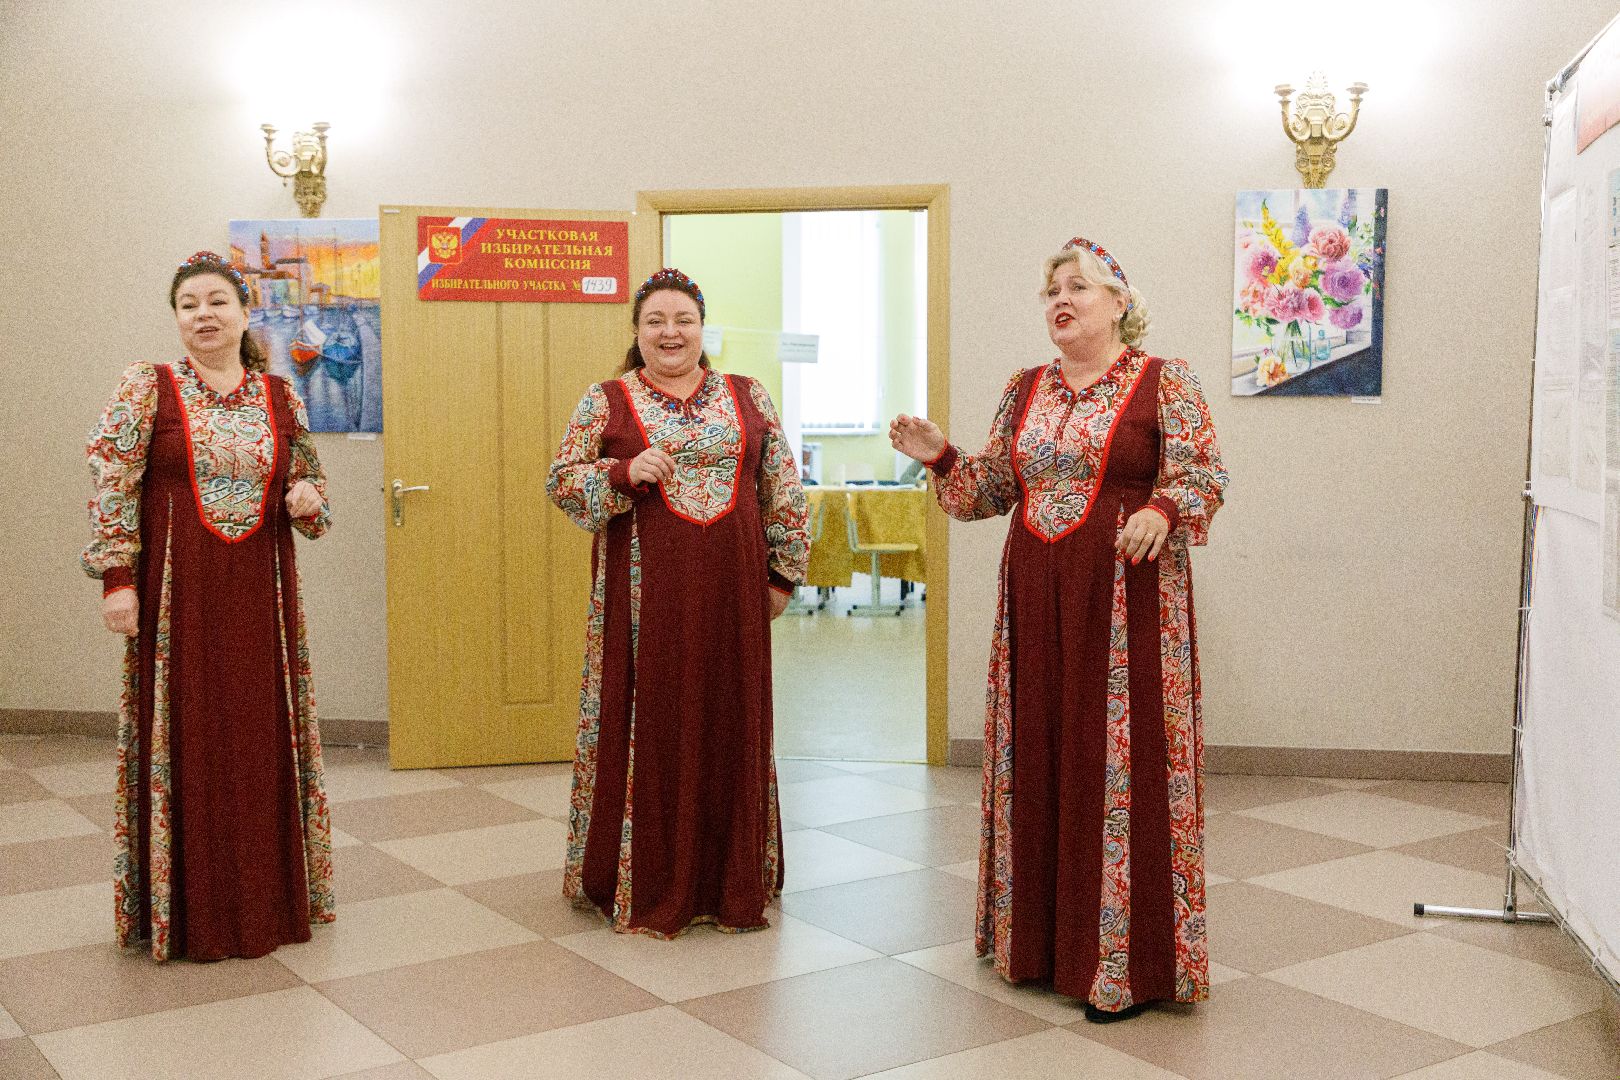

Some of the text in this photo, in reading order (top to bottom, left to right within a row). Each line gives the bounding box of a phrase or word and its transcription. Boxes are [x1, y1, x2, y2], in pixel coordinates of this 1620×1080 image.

[496, 228, 599, 242] УЧАСТКОВАЯ
[480, 243, 613, 256] ИЗБИРАТЕЛЬНАЯ
[504, 258, 591, 271] КОМИССИЯ
[432, 278, 519, 290] ИЗБИРАТЕЛЬНОГО
[523, 280, 566, 291] УЧАСТКА
